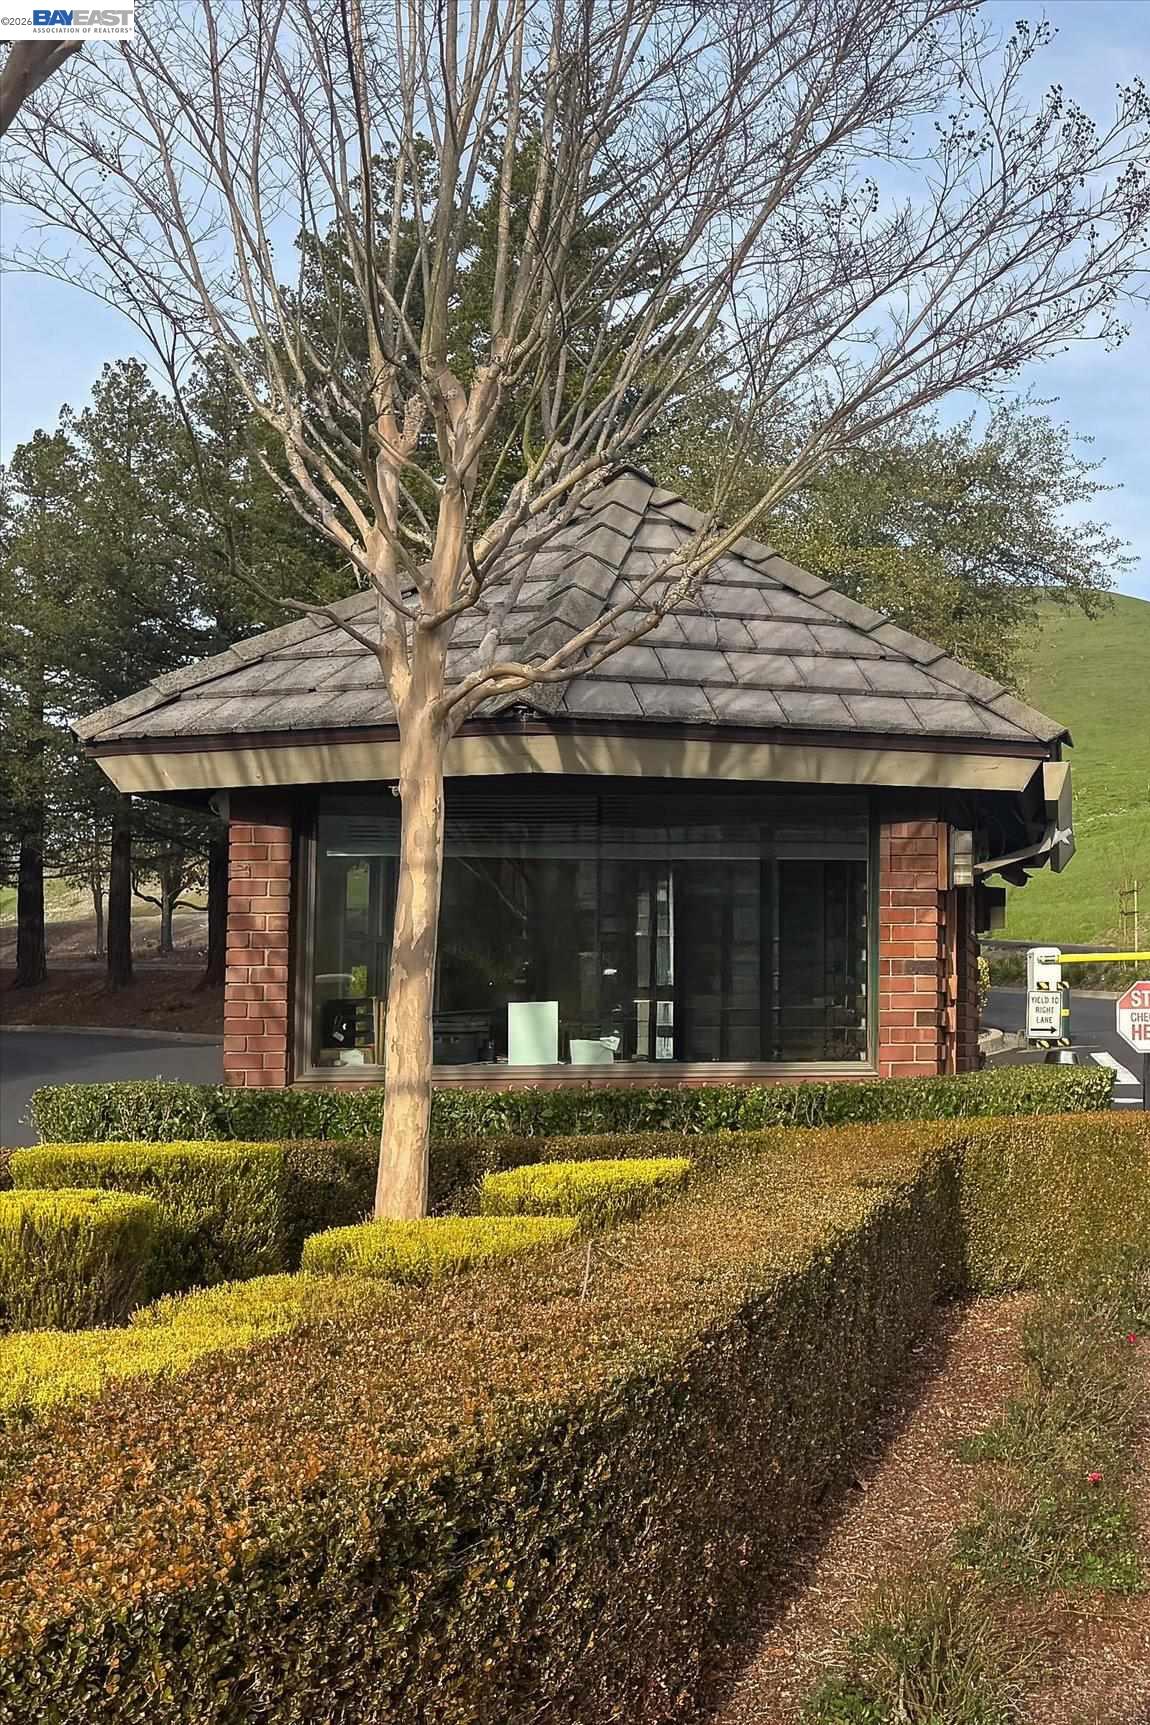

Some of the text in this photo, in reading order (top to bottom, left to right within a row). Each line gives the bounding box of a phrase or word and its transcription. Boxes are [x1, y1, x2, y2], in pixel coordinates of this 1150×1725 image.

[1031, 996, 1059, 1004] YIELD TO
[1035, 1006, 1054, 1014] RIGHT
[1036, 1016, 1053, 1024] LANE
